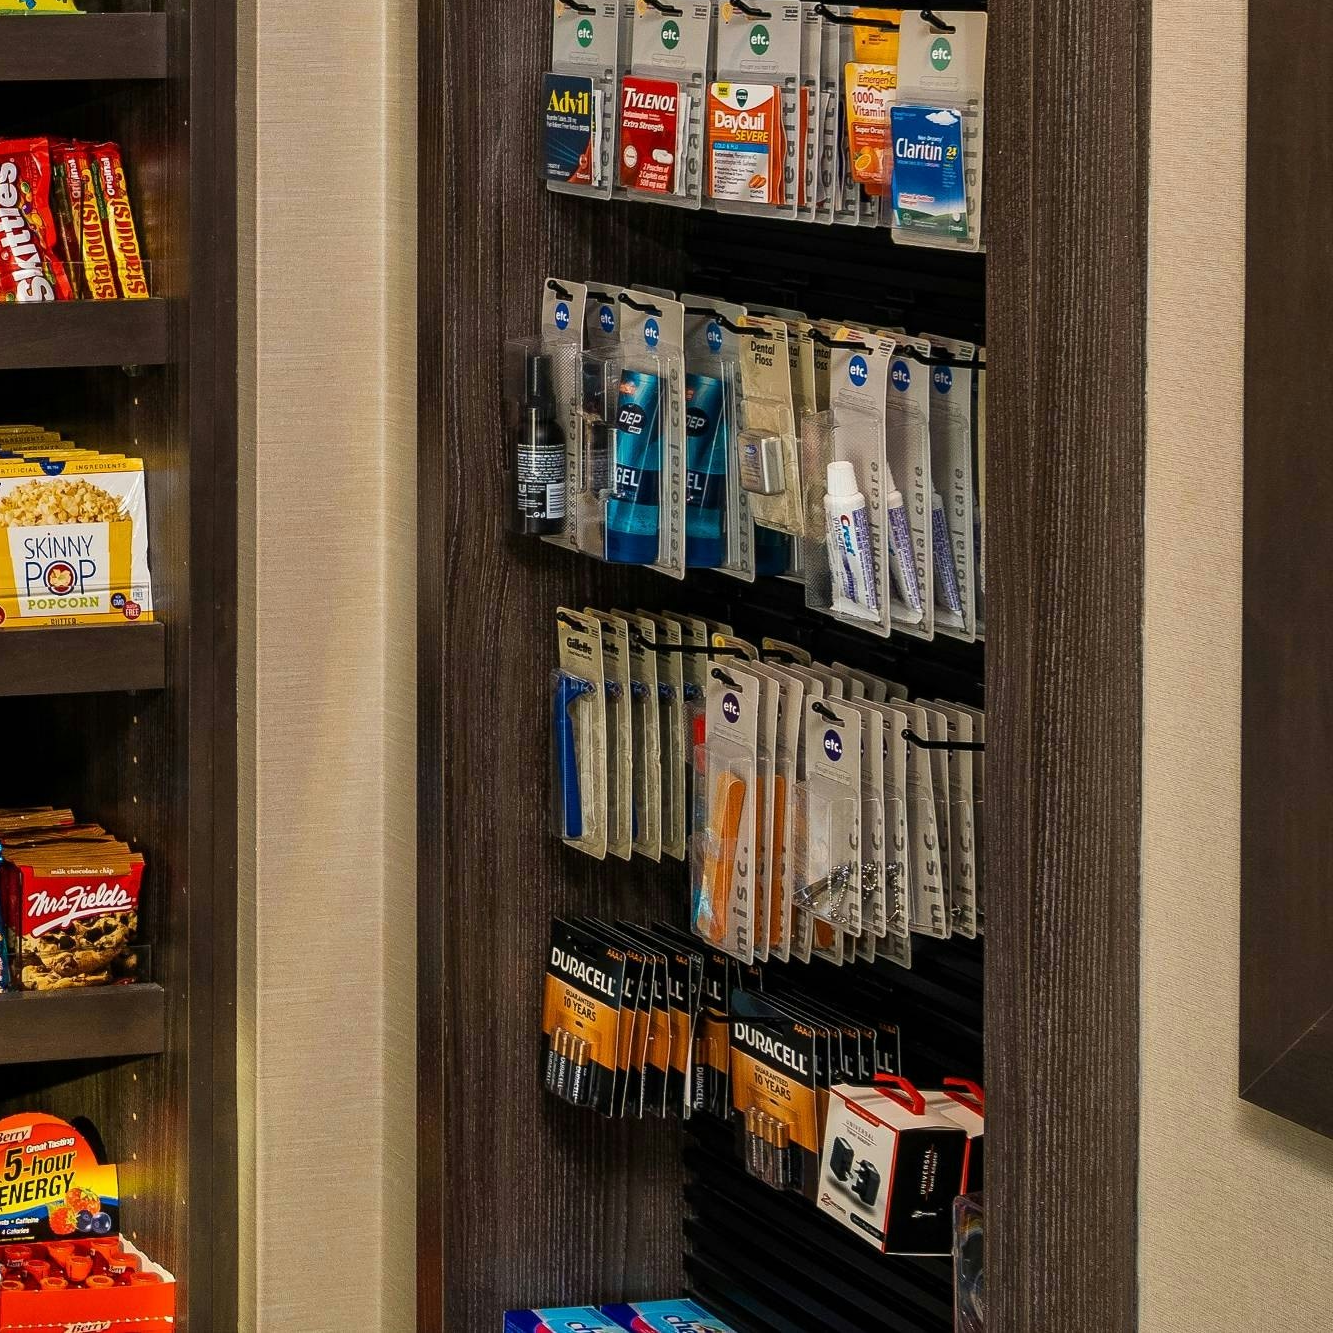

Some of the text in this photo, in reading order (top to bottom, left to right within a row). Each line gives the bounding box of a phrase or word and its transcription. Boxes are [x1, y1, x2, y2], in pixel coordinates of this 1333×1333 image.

[751, 35, 769, 46] etc.
[932, 50, 951, 60] etc.
[858, 74, 896, 86] Emergen-C
[547, 90, 590, 115] Advil
[624, 87, 676, 112] TYLENOL
[853, 106, 885, 117] Vitamin
[640, 121, 664, 132] Strength
[715, 111, 765, 134] DayQuil
[735, 130, 769, 143] SEVERE
[896, 138, 942, 161] Claritin
[68, 158, 81, 199] original
[100, 157, 116, 196] original
[645, 328, 659, 339] etc.
[750, 341, 775, 356] Dental
[754, 355, 773, 366] Floss
[850, 365, 868, 378] etc.
[892, 371, 910, 383] etc.
[619, 411, 642, 427] DEP
[75, 462, 127, 471] INGREDIENTS
[614, 469, 639, 487] GEL
[24, 533, 94, 560] SKINNY
[25, 559, 96, 596] POP
[27, 596, 100, 610] POPCORN
[99, 868, 114, 876] chip
[551, 946, 615, 998] DURACELL
[563, 995, 596, 1023] 10 YEARS
[734, 1021, 808, 1077] DURACELL
[764, 1077, 792, 1102] YEARS
[26, 1137, 76, 1154] Great Tasting
[4, 1147, 78, 1182] 5-hour
